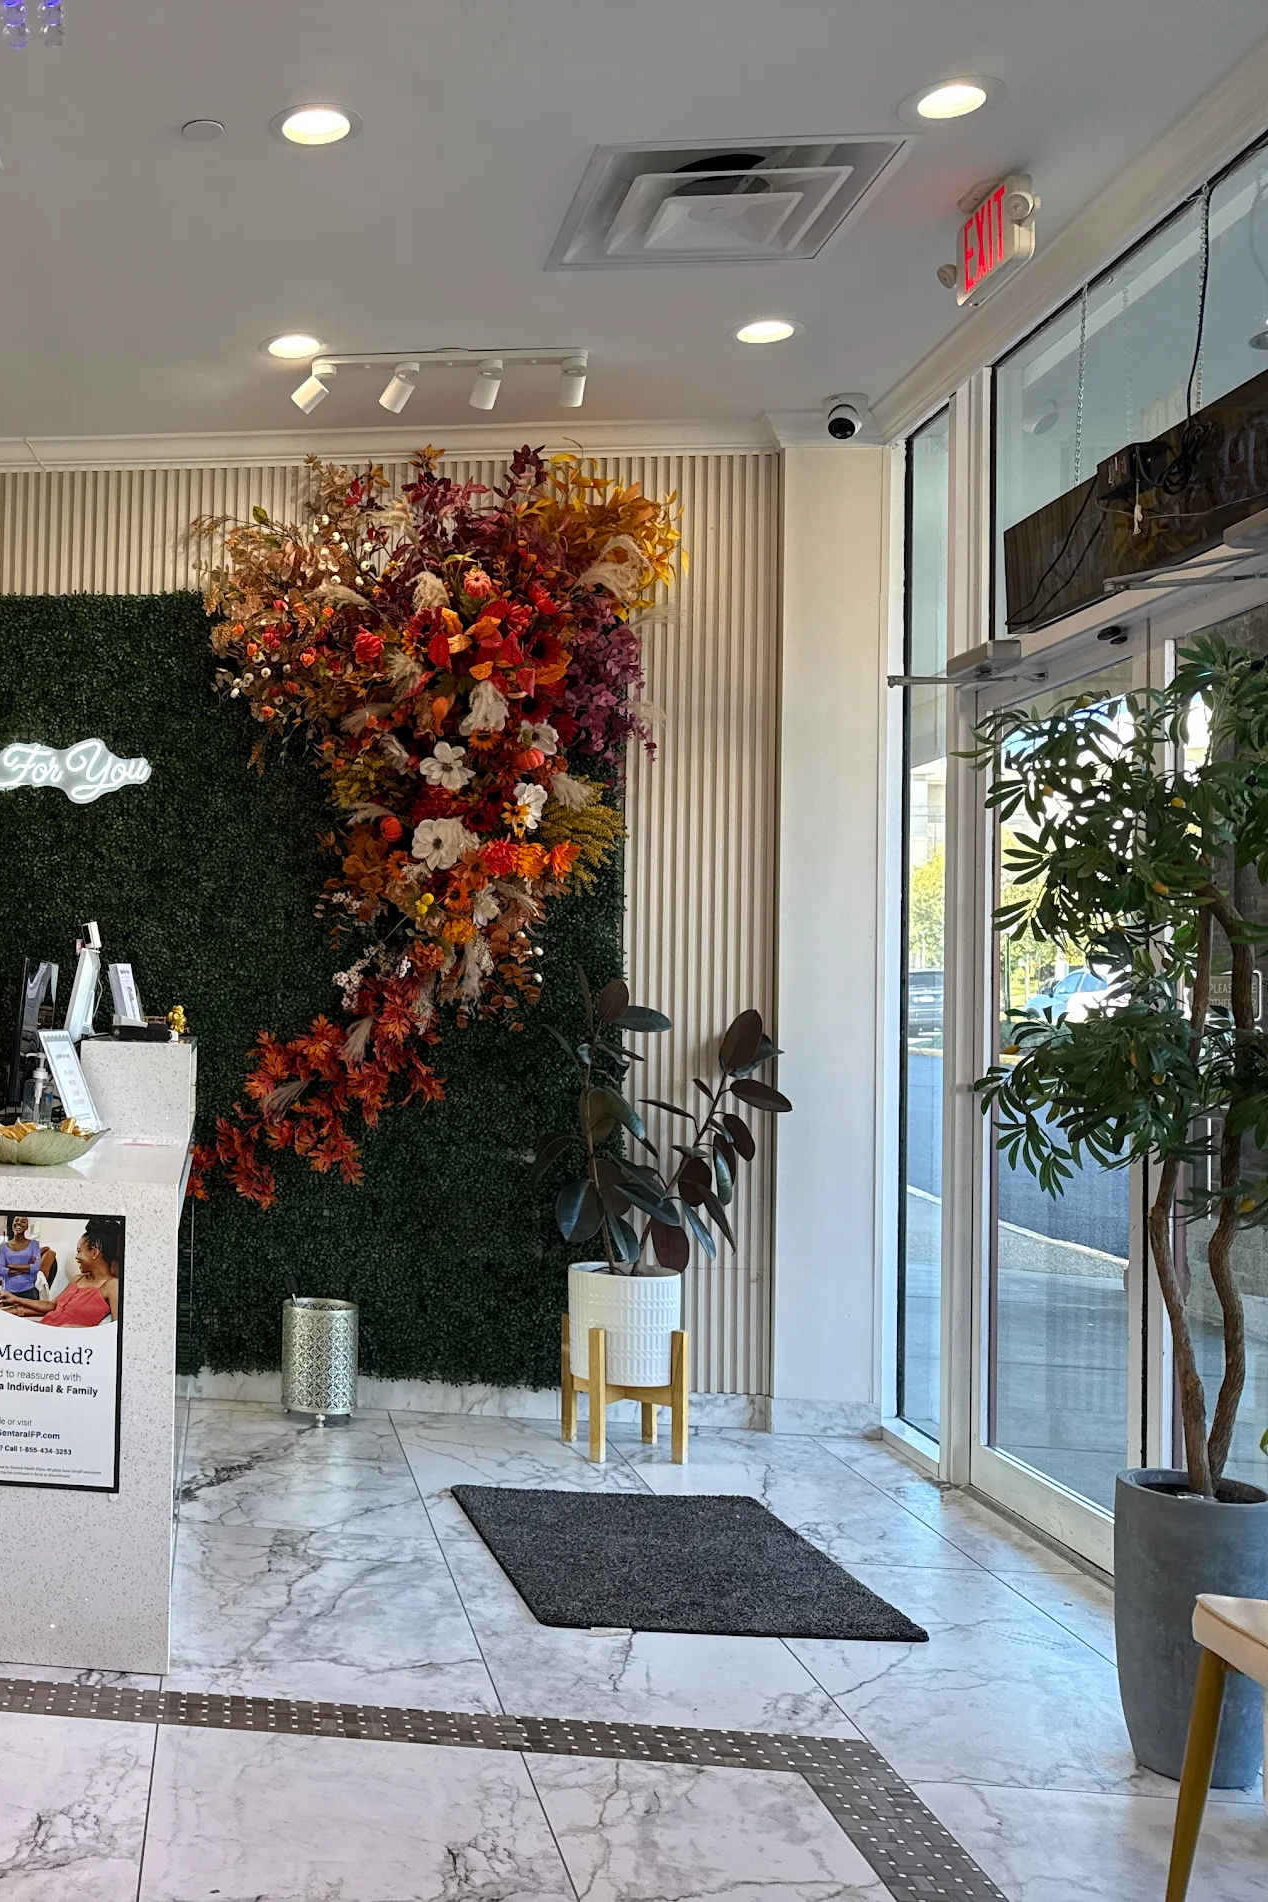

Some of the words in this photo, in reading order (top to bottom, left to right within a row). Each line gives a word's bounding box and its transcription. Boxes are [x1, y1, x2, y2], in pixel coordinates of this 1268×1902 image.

[963, 184, 1006, 294] EXIT
[66, 740, 147, 799] You
[5, 1370, 15, 1378] to
[17, 1371, 60, 1381] reassured
[62, 1373, 82, 1382] with
[7, 1382, 53, 1393] Individual
[55, 1385, 64, 1394] &
[66, 1386, 98, 1397] Family
[17, 1418, 32, 1427] visit
